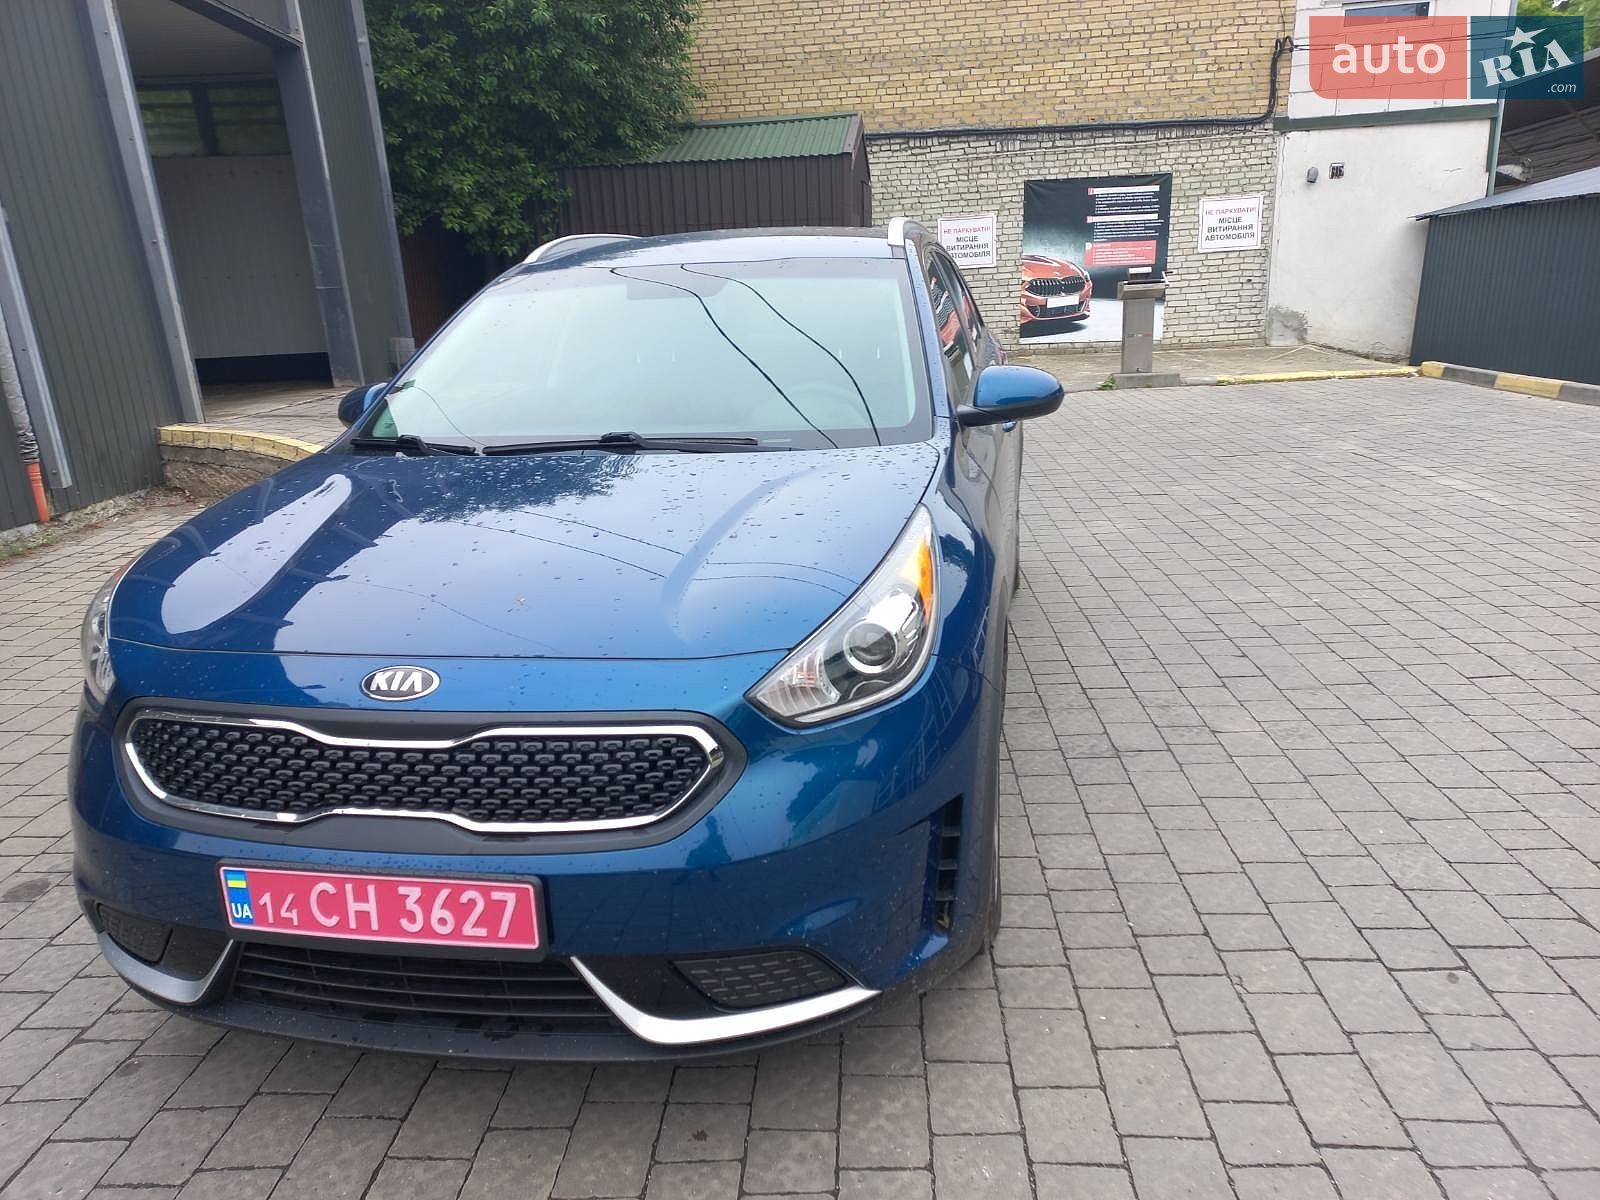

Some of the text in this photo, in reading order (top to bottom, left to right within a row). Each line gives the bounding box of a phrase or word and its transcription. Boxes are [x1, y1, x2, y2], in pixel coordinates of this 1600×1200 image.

[1219, 216, 1243, 224] МІСЦЕ
[1207, 224, 1254, 233] ВИТИРАННЯ
[956, 235, 979, 243] МІСЦЕ
[1205, 232, 1255, 241] АВТОМОБІЛЯ
[950, 250, 991, 259] ТОМОБІЛЯ
[370, 671, 423, 692] KIA
[231, 902, 253, 919] UA
[258, 892, 299, 926] 14
[397, 886, 517, 938] 3627
